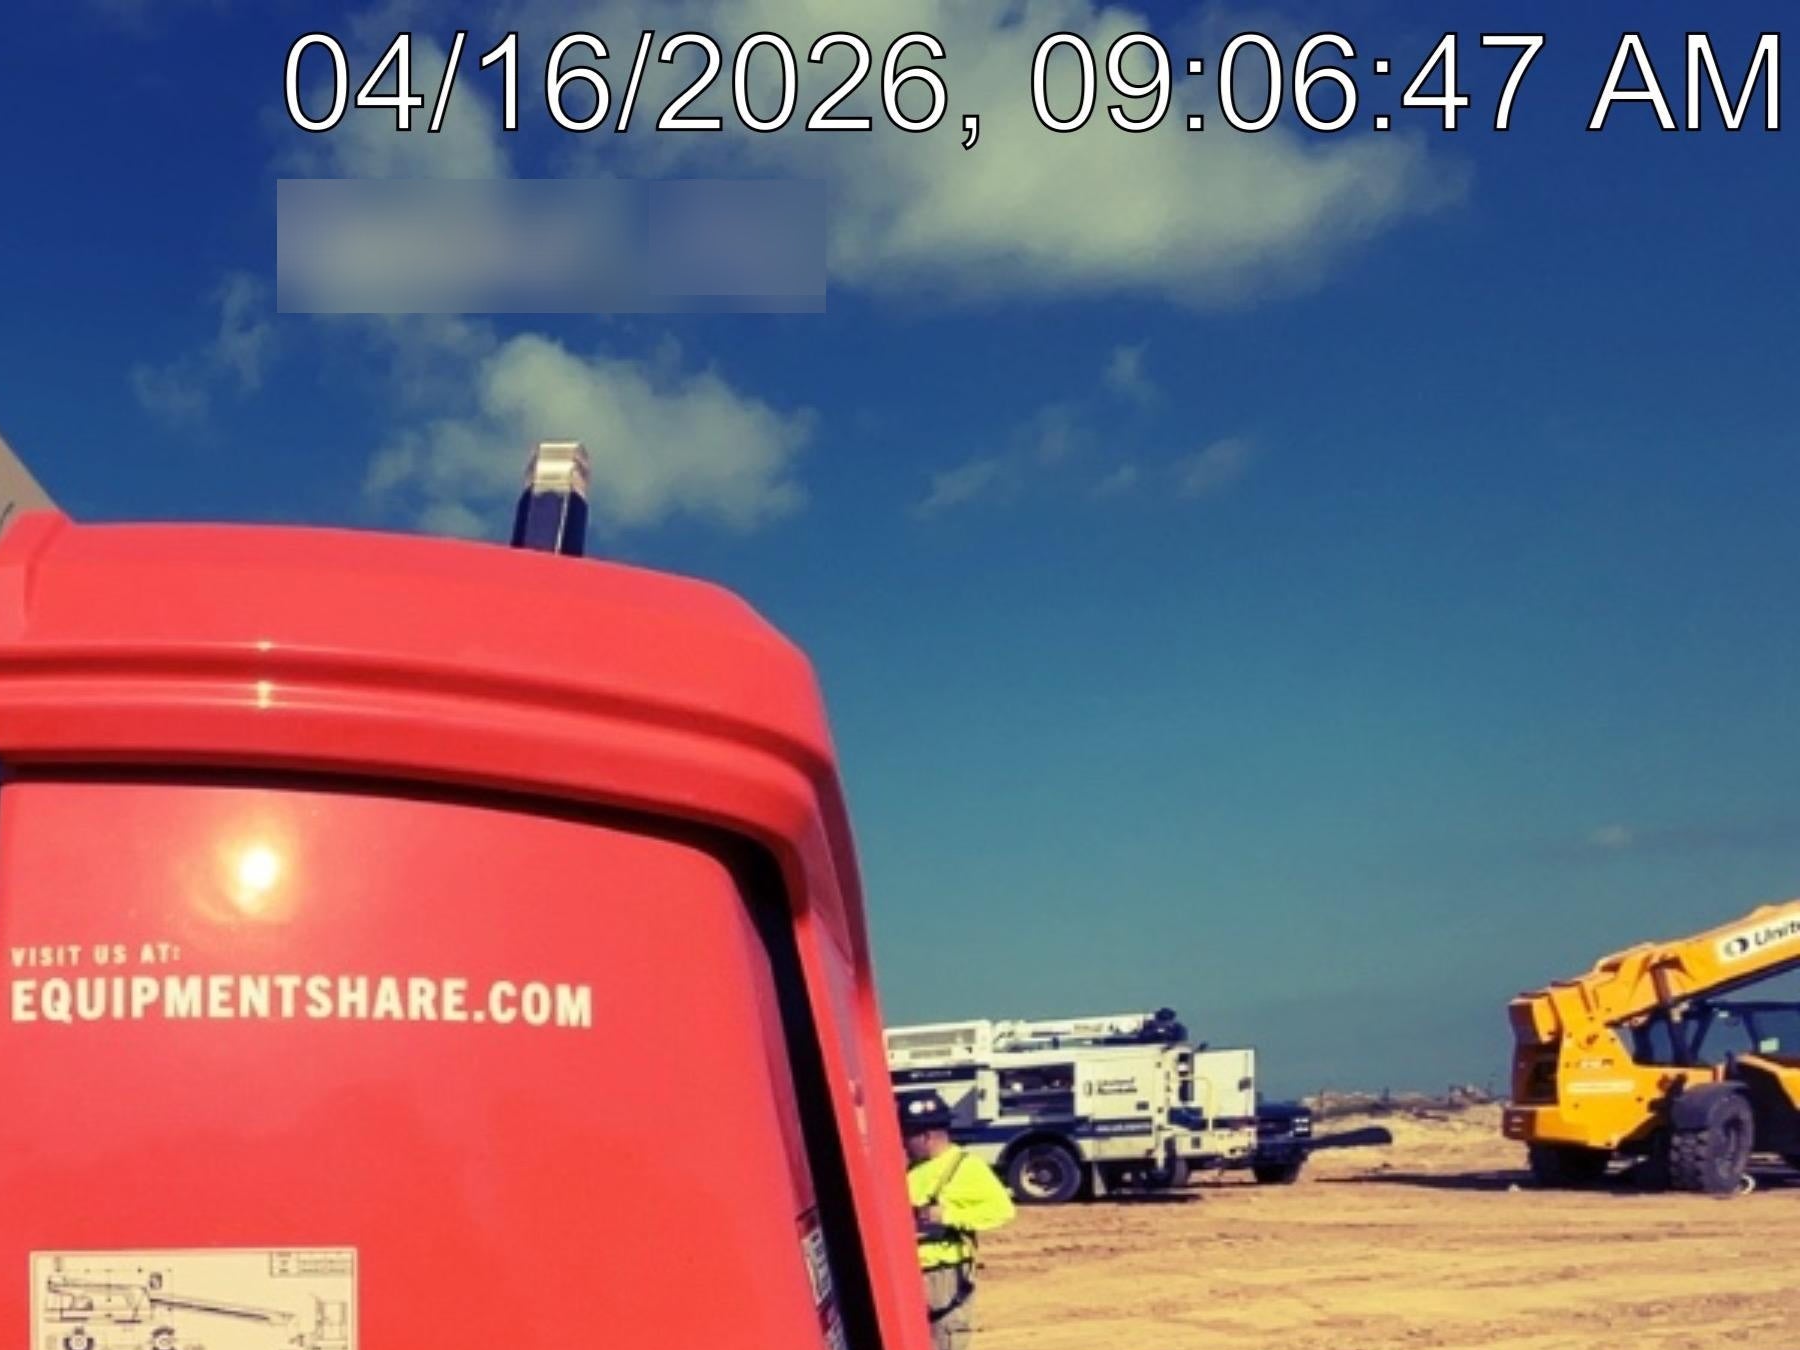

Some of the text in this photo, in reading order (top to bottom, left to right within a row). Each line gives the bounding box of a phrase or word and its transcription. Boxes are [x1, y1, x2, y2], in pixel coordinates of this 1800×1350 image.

[11, 941, 181, 968] VISIT US AT:
[11, 974, 593, 1029] EQUIPMENTSHARE.COM
